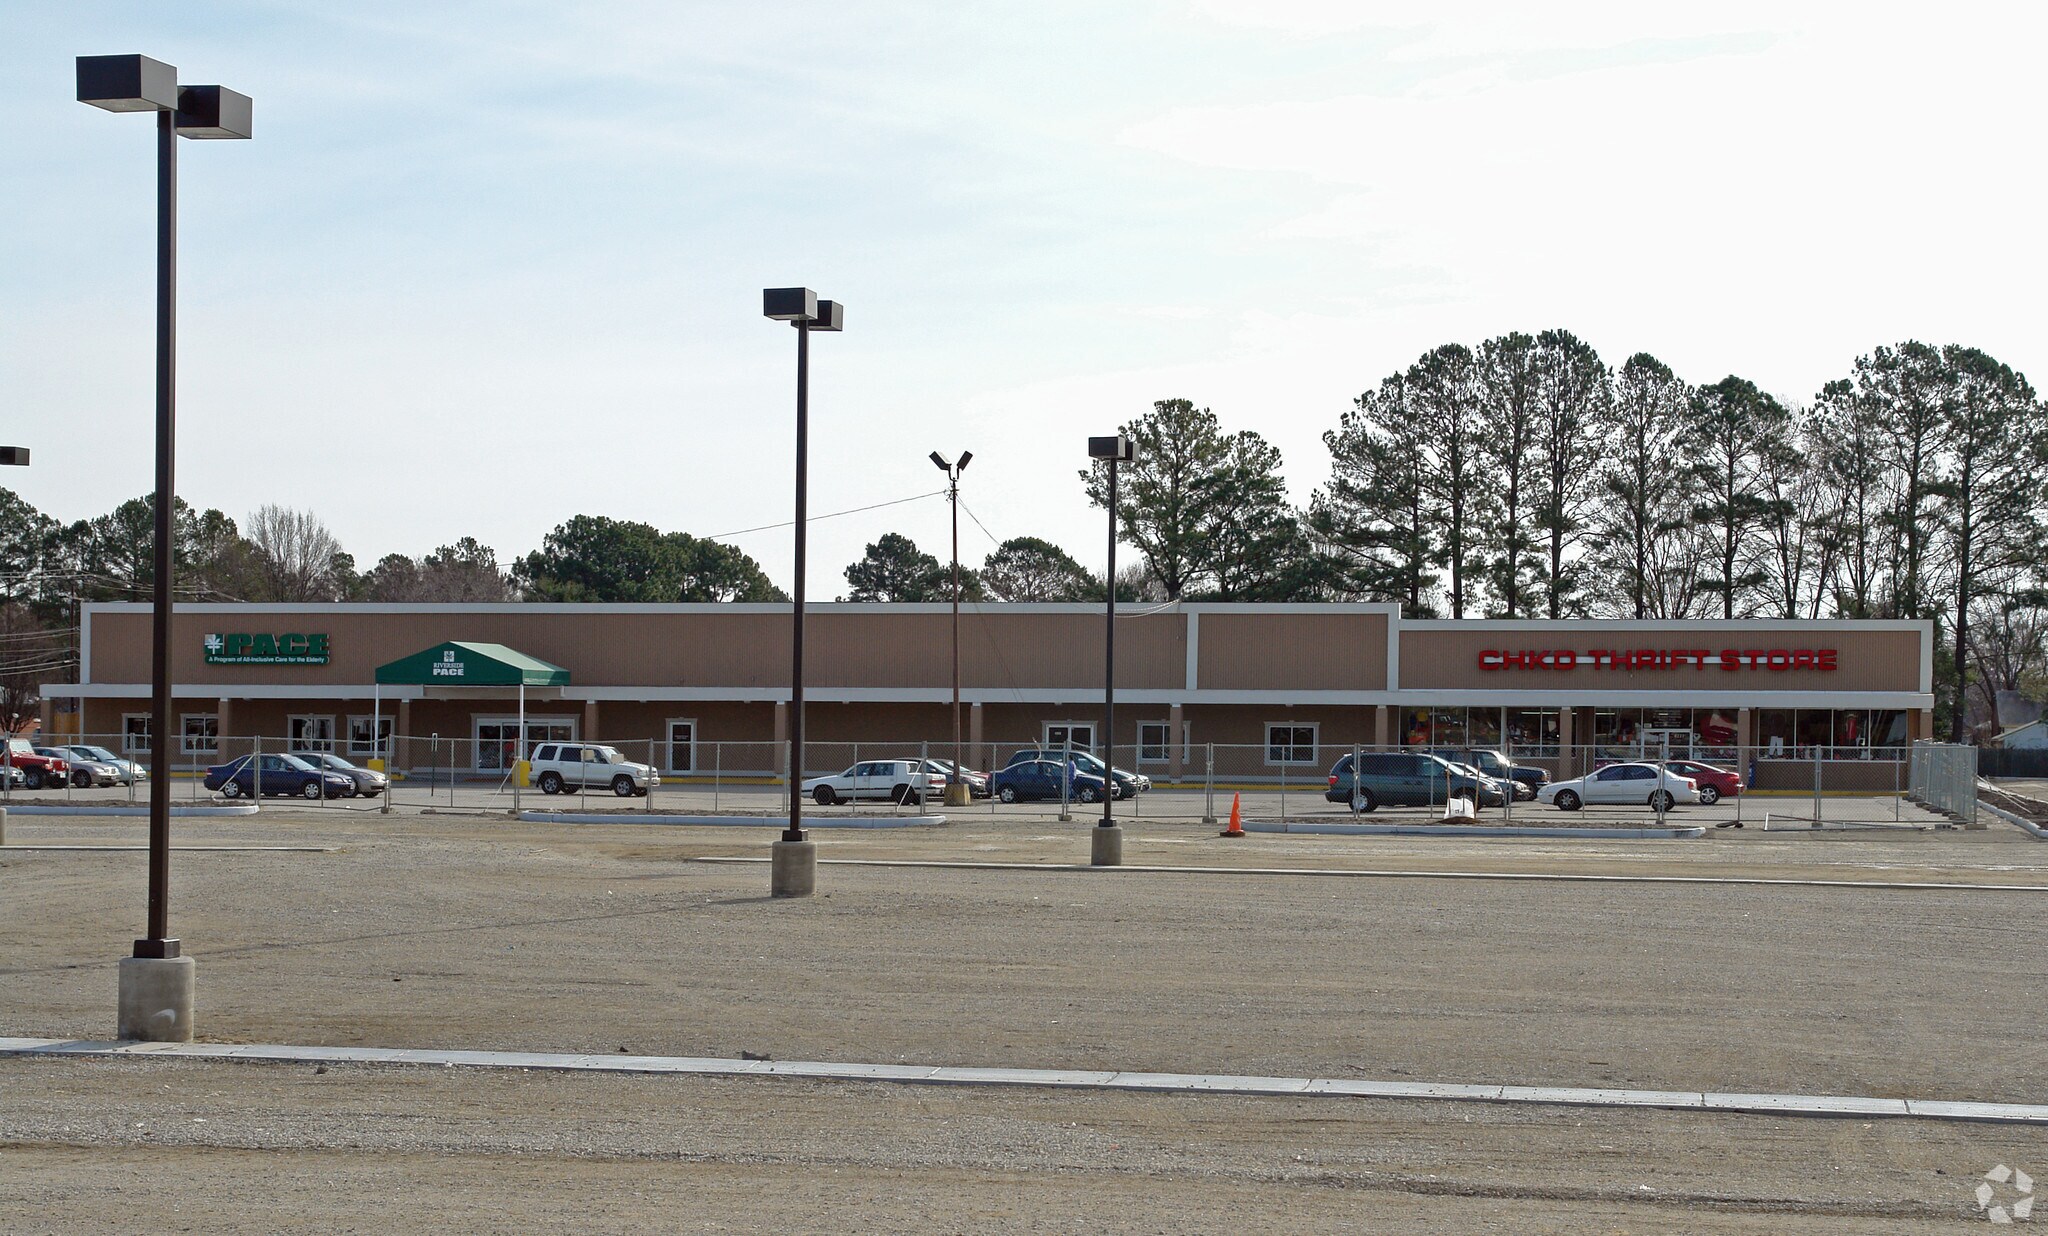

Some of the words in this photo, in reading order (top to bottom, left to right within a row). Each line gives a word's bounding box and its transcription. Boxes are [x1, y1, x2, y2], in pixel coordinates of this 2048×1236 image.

[227, 633, 329, 655] PACE
[214, 656, 236, 664] Program
[306, 656, 325, 664] Elderly
[1479, 649, 1577, 671] CHKD
[1588, 649, 1711, 671] THRIFT
[1720, 649, 1838, 671] STORE
[433, 668, 464, 676] PACE
